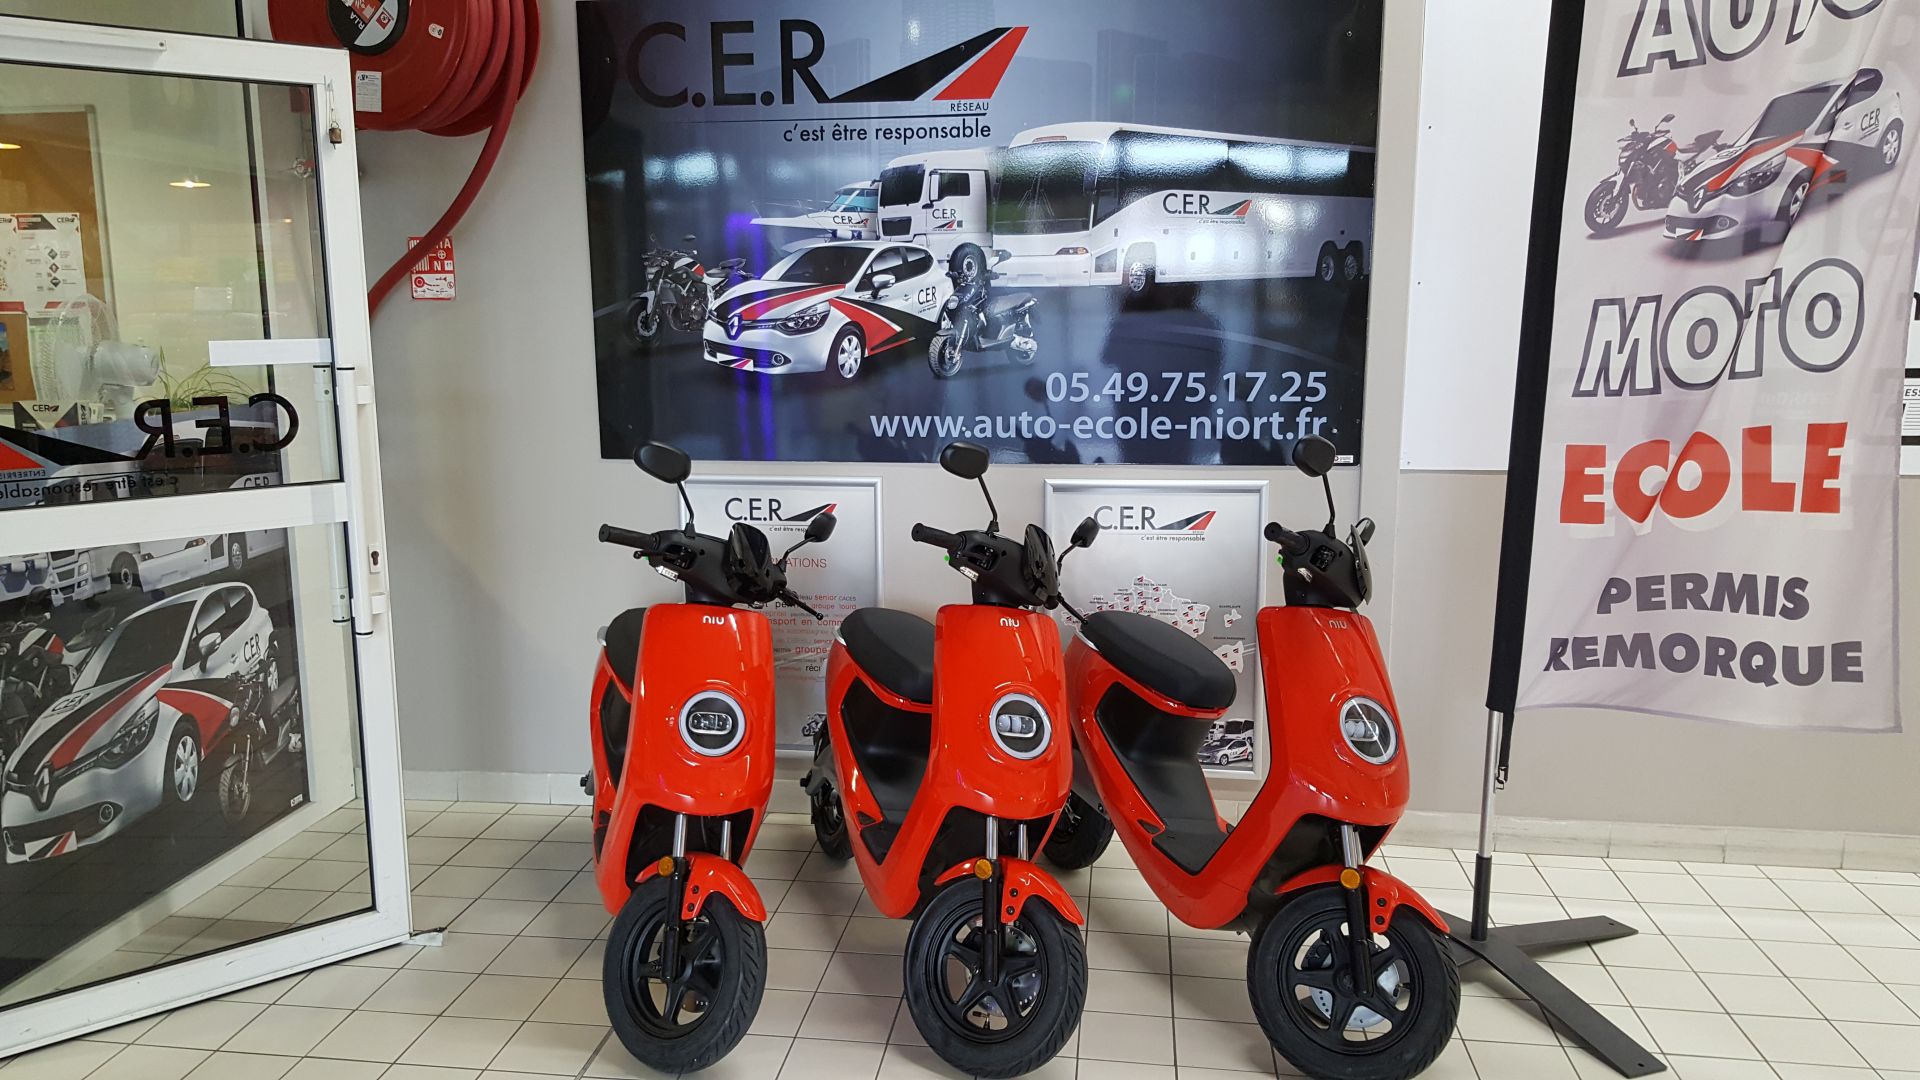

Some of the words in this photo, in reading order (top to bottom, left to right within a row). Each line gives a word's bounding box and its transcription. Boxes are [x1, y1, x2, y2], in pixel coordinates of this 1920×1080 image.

[1617, 0, 1883, 78] AU
[950, 102, 989, 112] RÉSEAU
[831, 123, 868, 141] être
[875, 117, 991, 145] responsable
[932, 208, 957, 219] C.E.R
[1162, 193, 1210, 215] C.E.R
[1572, 258, 1864, 397] MOTO
[1045, 372, 1327, 402] 05.49.75.17.25
[870, 407, 1328, 440] www.auto-ecole-niort.fr
[1560, 422, 1848, 524] ECOLE
[724, 498, 783, 521] C.E.R
[1093, 505, 1157, 530] C.E.R
[1169, 534, 1206, 543] responsable
[1596, 572, 1810, 621] PERMIS
[702, 615, 725, 625] niu
[801, 618, 813, 626] en
[999, 617, 1020, 628] niu
[1328, 620, 1347, 629] niu
[794, 646, 828, 655] groupe
[1543, 632, 1864, 687] REMORQUE
